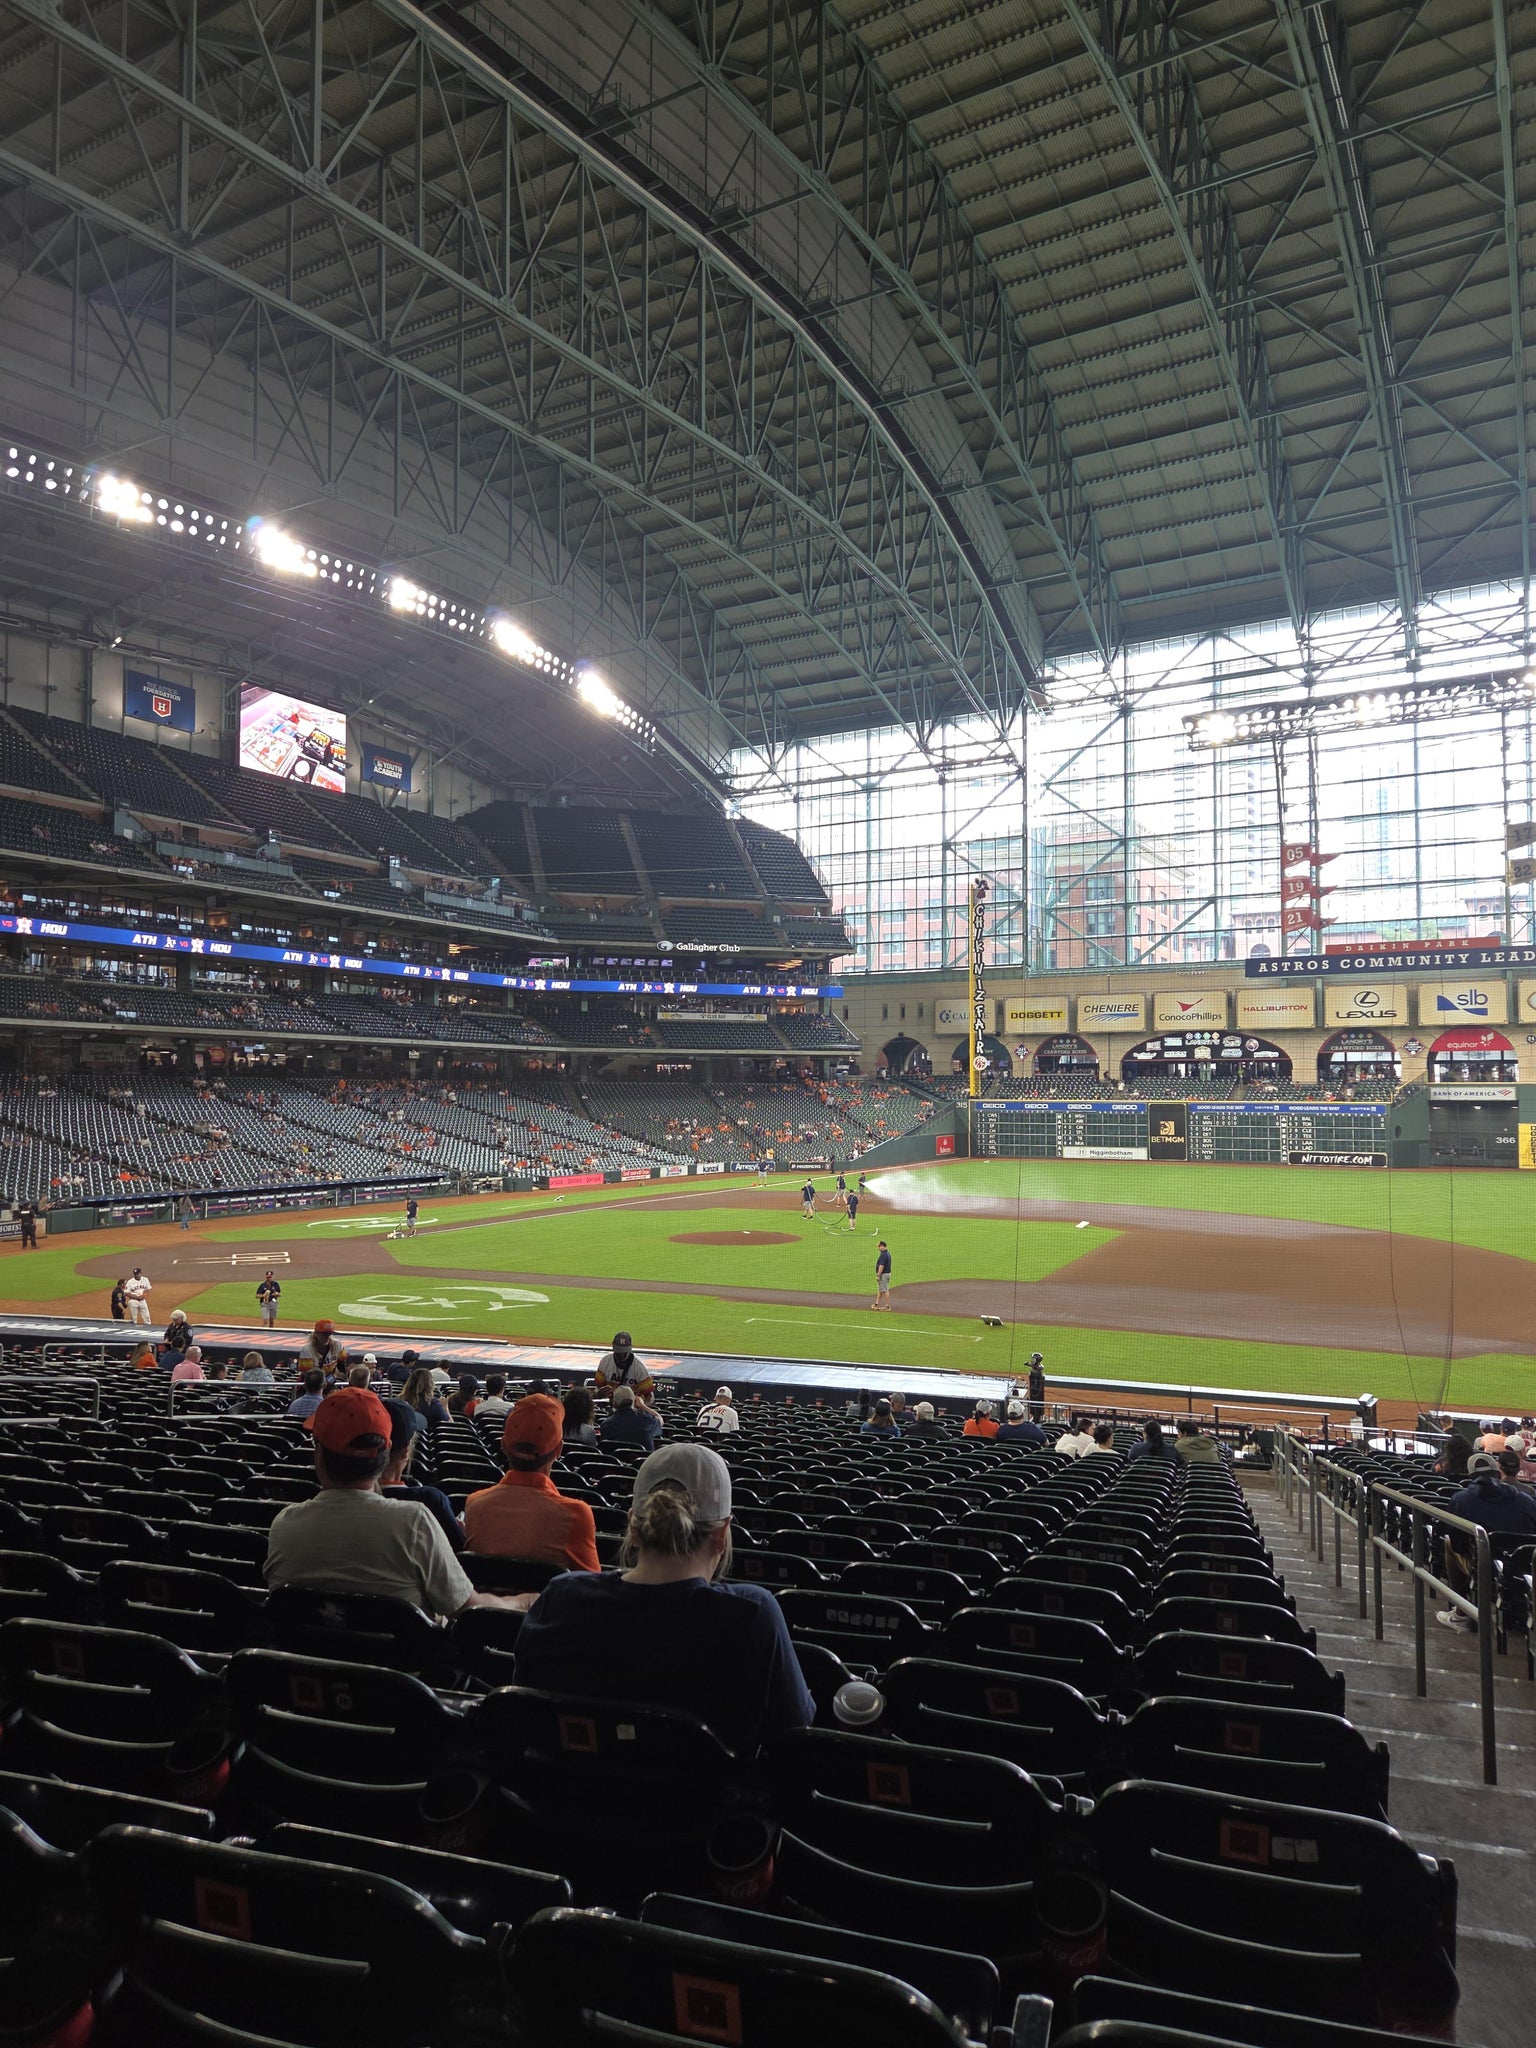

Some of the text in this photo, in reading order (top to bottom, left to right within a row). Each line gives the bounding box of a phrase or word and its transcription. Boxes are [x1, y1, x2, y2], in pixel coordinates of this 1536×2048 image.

[143, 685, 181, 701] FOUNDATION
[157, 702, 167, 712] H
[373, 766, 402, 780] ACADEMY
[1286, 847, 1304, 861] 05
[1513, 864, 1533, 878] 22
[1288, 881, 1304, 894] 19
[1287, 911, 1303, 925] 21
[40, 922, 68, 935] HOU
[132, 933, 158, 946] ATH
[210, 942, 232, 954] HOU
[676, 942, 718, 953] Gallagher
[719, 943, 741, 952] Club
[1345, 939, 1470, 952] DAIKIN PARK
[282, 951, 303, 962] ATH
[344, 959, 363, 969] HOU
[1258, 959, 1330, 973] ASTROS
[1340, 953, 1470, 969] COMMUNITY
[403, 966, 420, 975] ATH
[502, 977, 517, 987] ATH
[617, 982, 637, 991] ATH
[679, 984, 698, 993] HOU
[742, 986, 761, 995] ATH
[801, 987, 819, 996] HOU
[1457, 989, 1489, 1006] slb
[1083, 1003, 1139, 1013] CHENIERE
[1010, 1010, 1064, 1019] DOGGETT
[1158, 1012, 1222, 1022] ConocoPhillips
[1335, 1010, 1397, 1019] LEXUS
[1446, 1042, 1478, 1050] equinor
[1151, 1136, 1185, 1144] BETMGM
[1495, 1136, 1516, 1144] 366
[1301, 1153, 1373, 1165] NITTOTIRE.COM
[700, 1415, 724, 1429] 27
